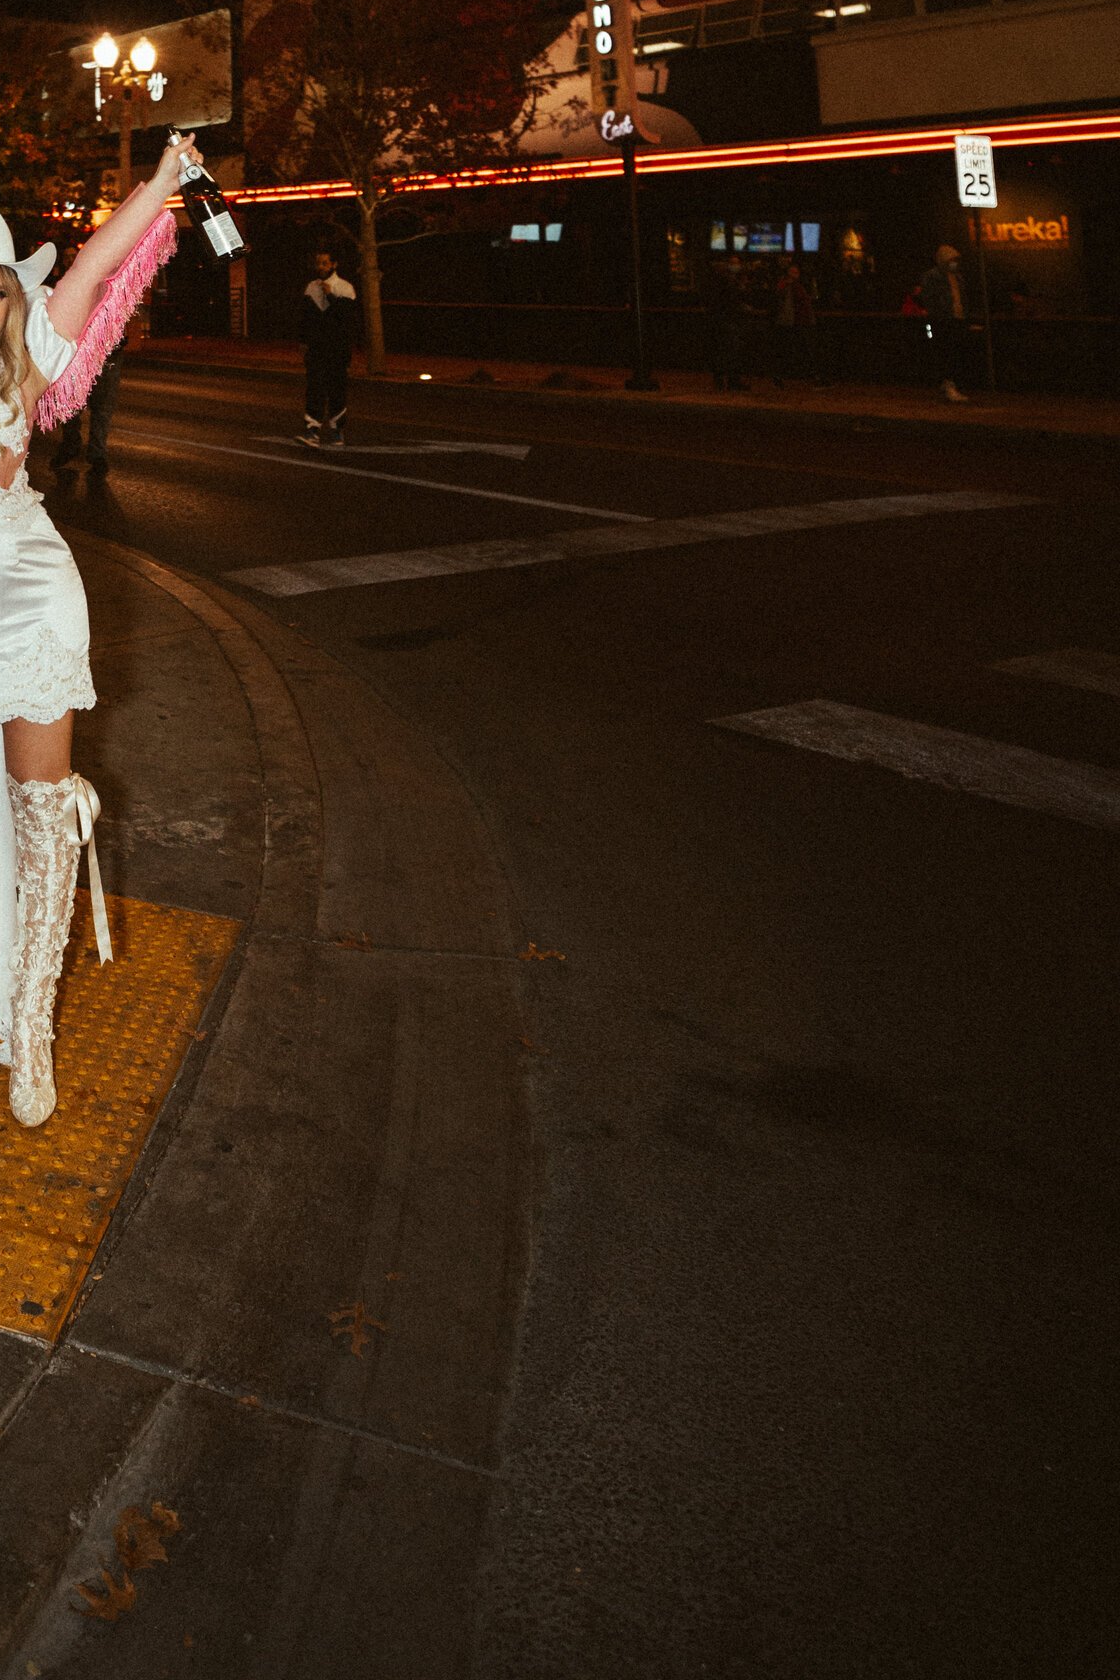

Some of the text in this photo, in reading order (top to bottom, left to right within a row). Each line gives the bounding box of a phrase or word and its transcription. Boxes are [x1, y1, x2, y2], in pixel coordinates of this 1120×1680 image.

[601, 109, 634, 141] East
[960, 143, 989, 156] SPEED
[964, 159, 987, 170] LIMIT
[963, 173, 991, 197] 25
